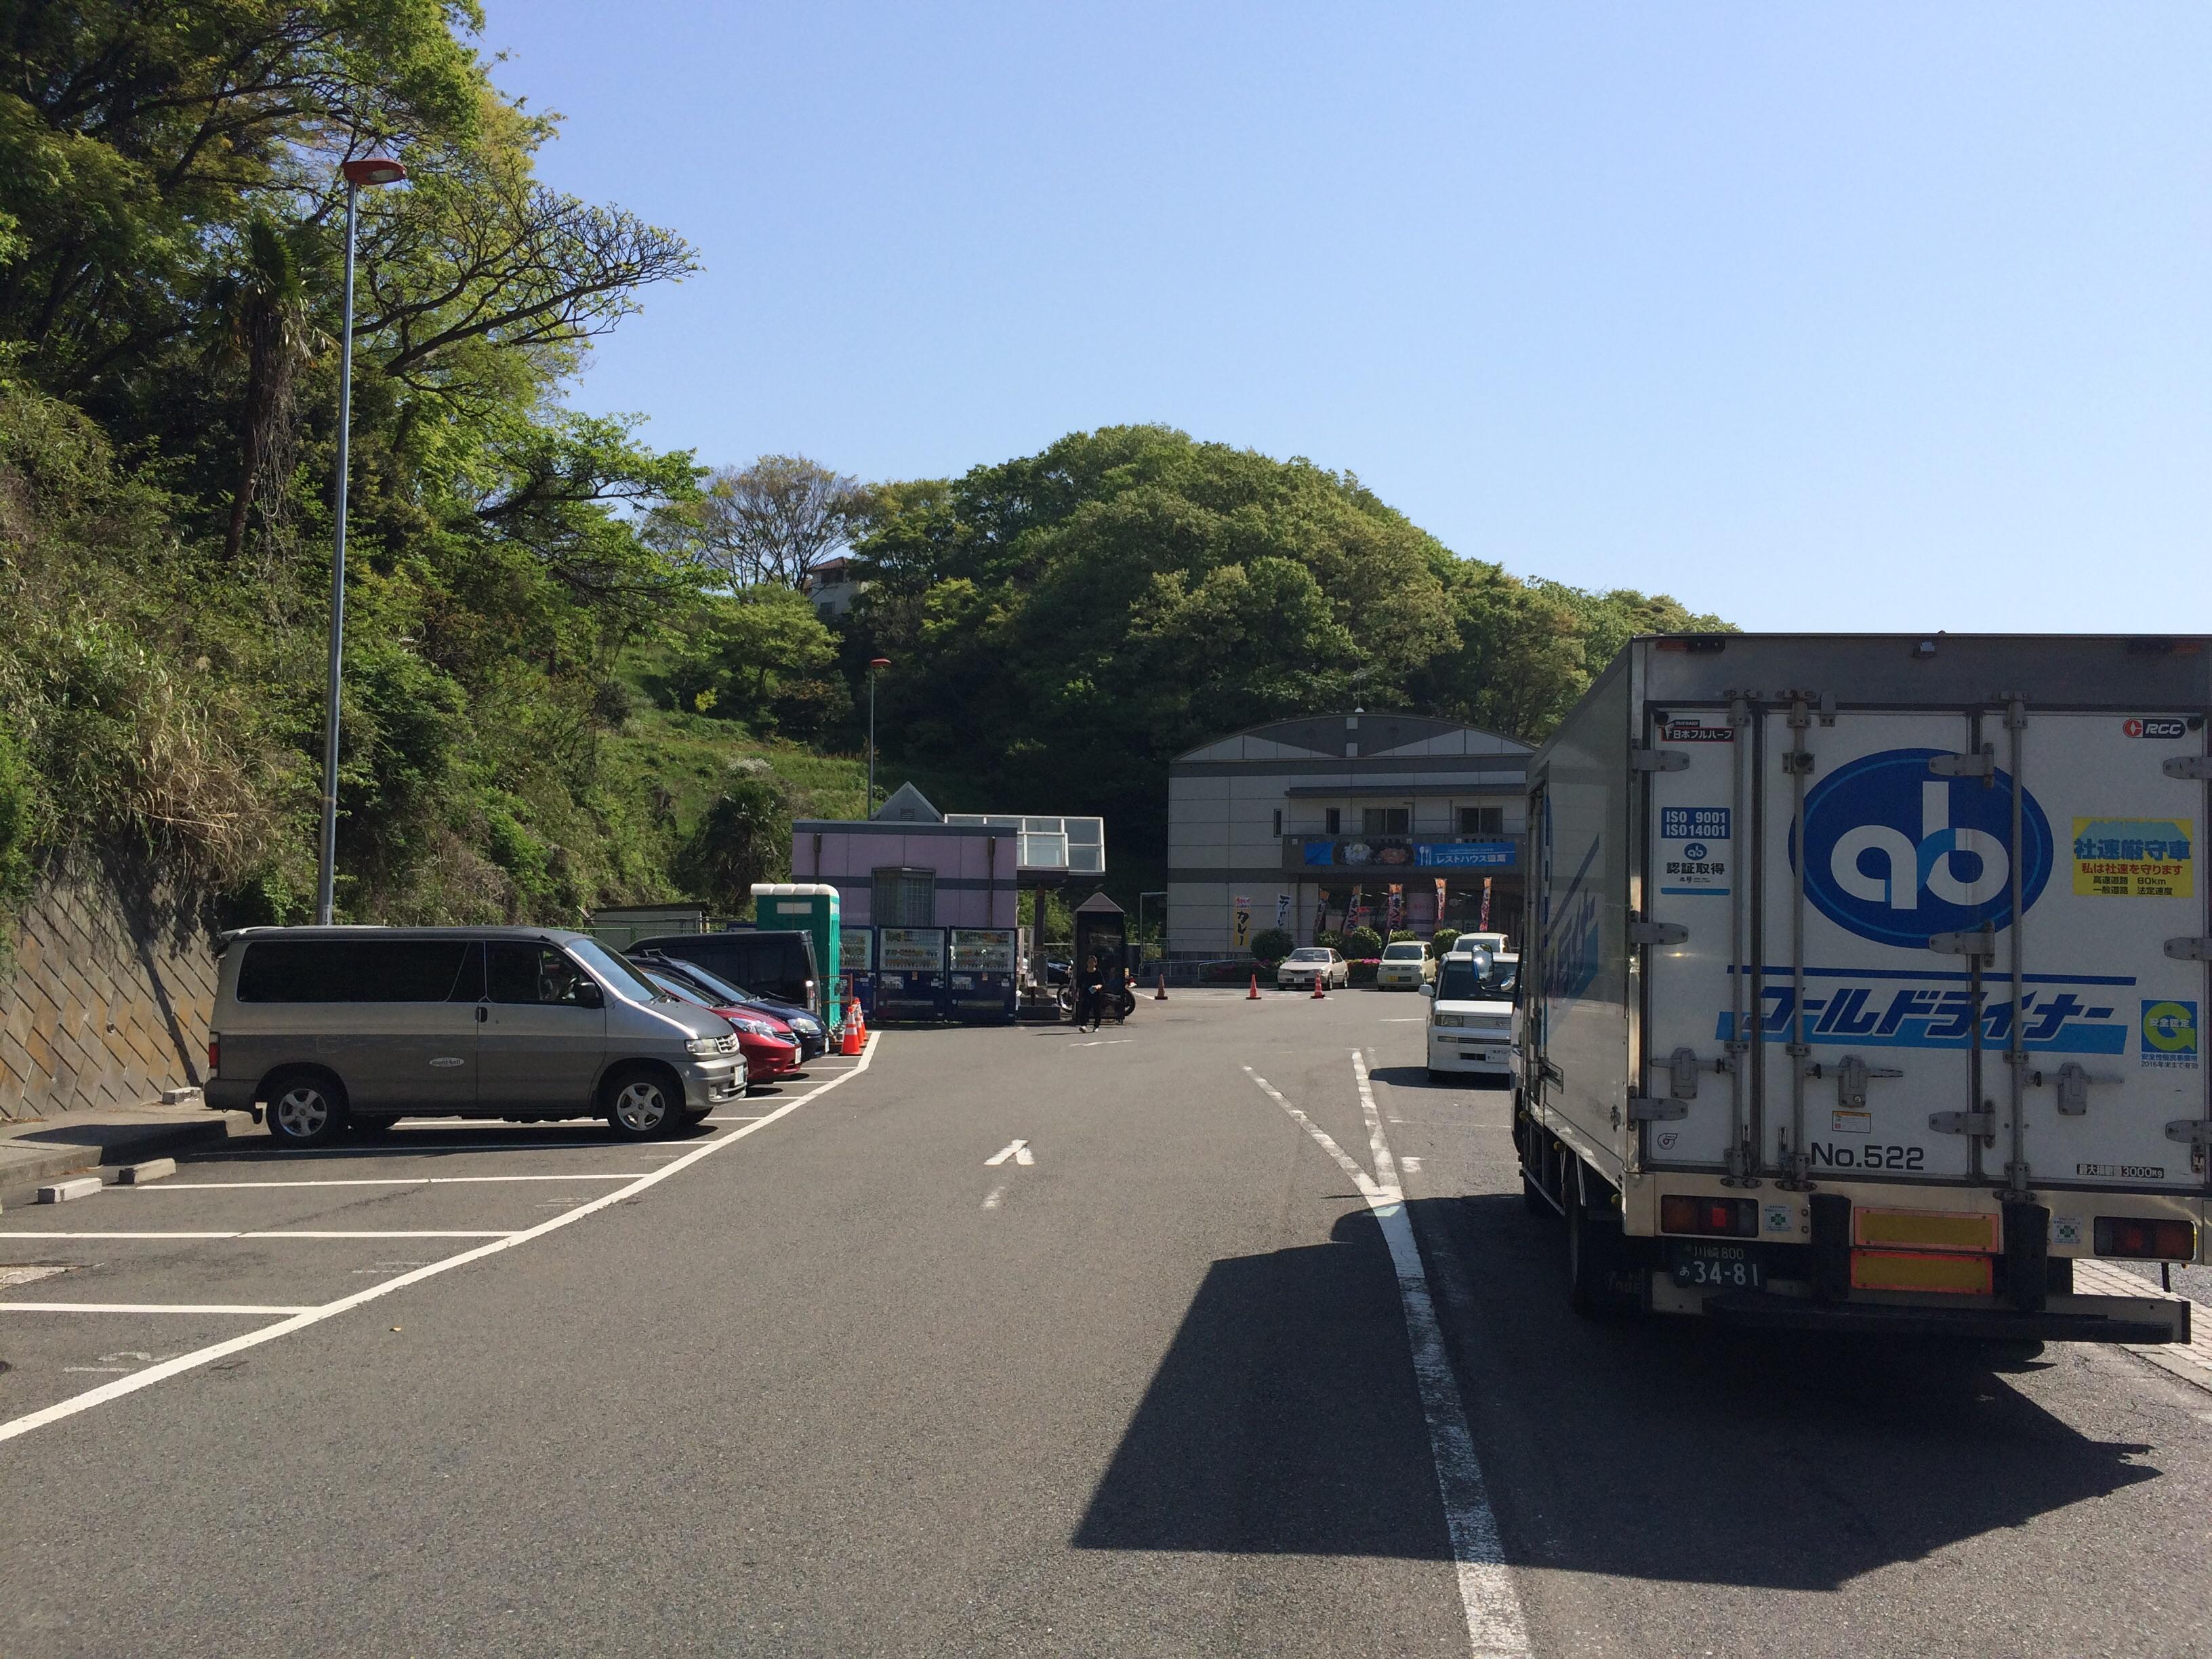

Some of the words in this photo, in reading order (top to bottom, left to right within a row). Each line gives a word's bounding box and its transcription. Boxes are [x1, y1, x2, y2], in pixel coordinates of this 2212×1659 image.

[1673, 729, 1732, 739] 日本フルハーフ
[1666, 811, 1687, 823] ISO
[1696, 811, 1726, 823] 9001
[2074, 838, 2191, 862] 社速厳守車
[1666, 861, 1725, 875] 認証取得
[2081, 863, 2183, 876] 私は社速を守ります
[2137, 876, 2167, 885] 80km
[1236, 910, 1250, 946] カレー
[1811, 1142, 1924, 1170] No.522
[1694, 1246, 1719, 1258] 川崎
[1721, 1246, 1744, 1260] 800
[1693, 1261, 1759, 1286] 34-81
